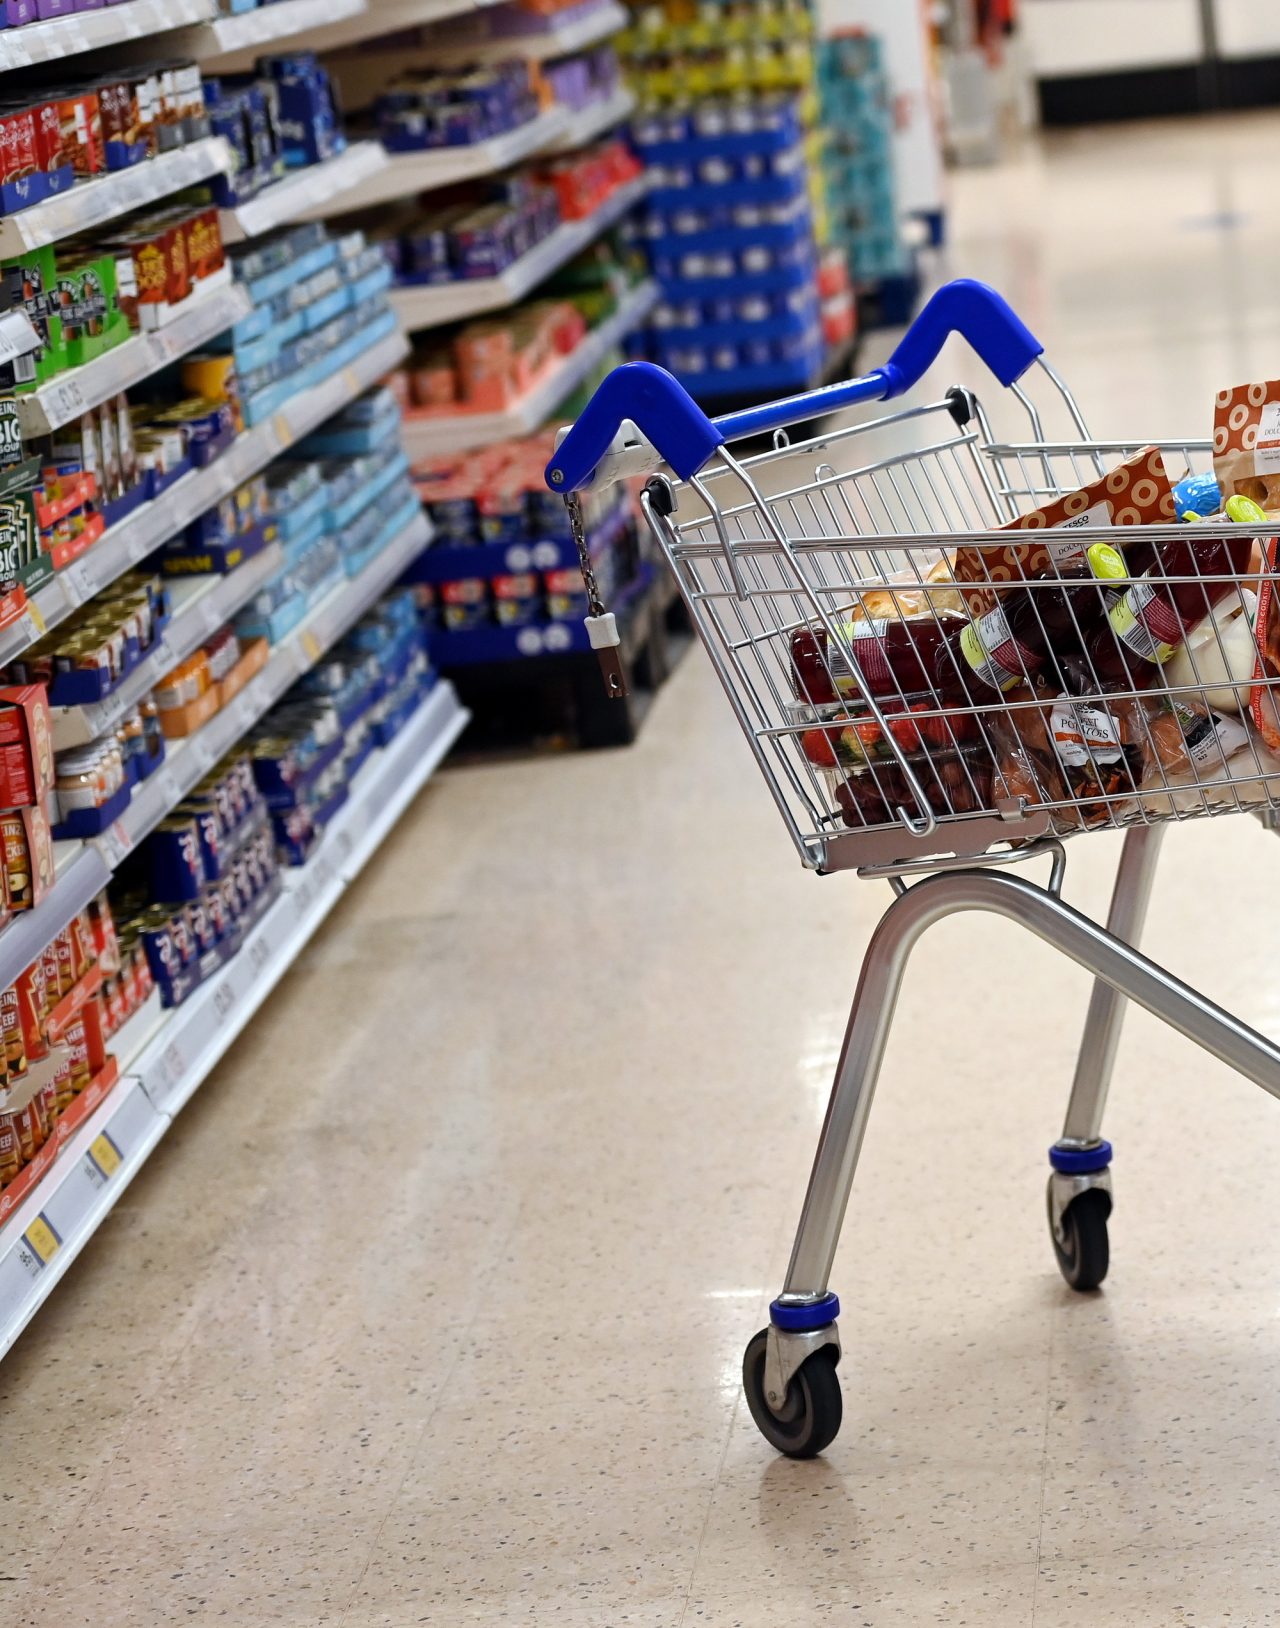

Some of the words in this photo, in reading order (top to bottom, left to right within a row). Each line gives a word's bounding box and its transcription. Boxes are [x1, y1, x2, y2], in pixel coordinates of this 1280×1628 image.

[1261, 581, 1270, 617] COOKING
[0, 991, 18, 1008] EINZ
[3, 1011, 16, 1027] EEF
